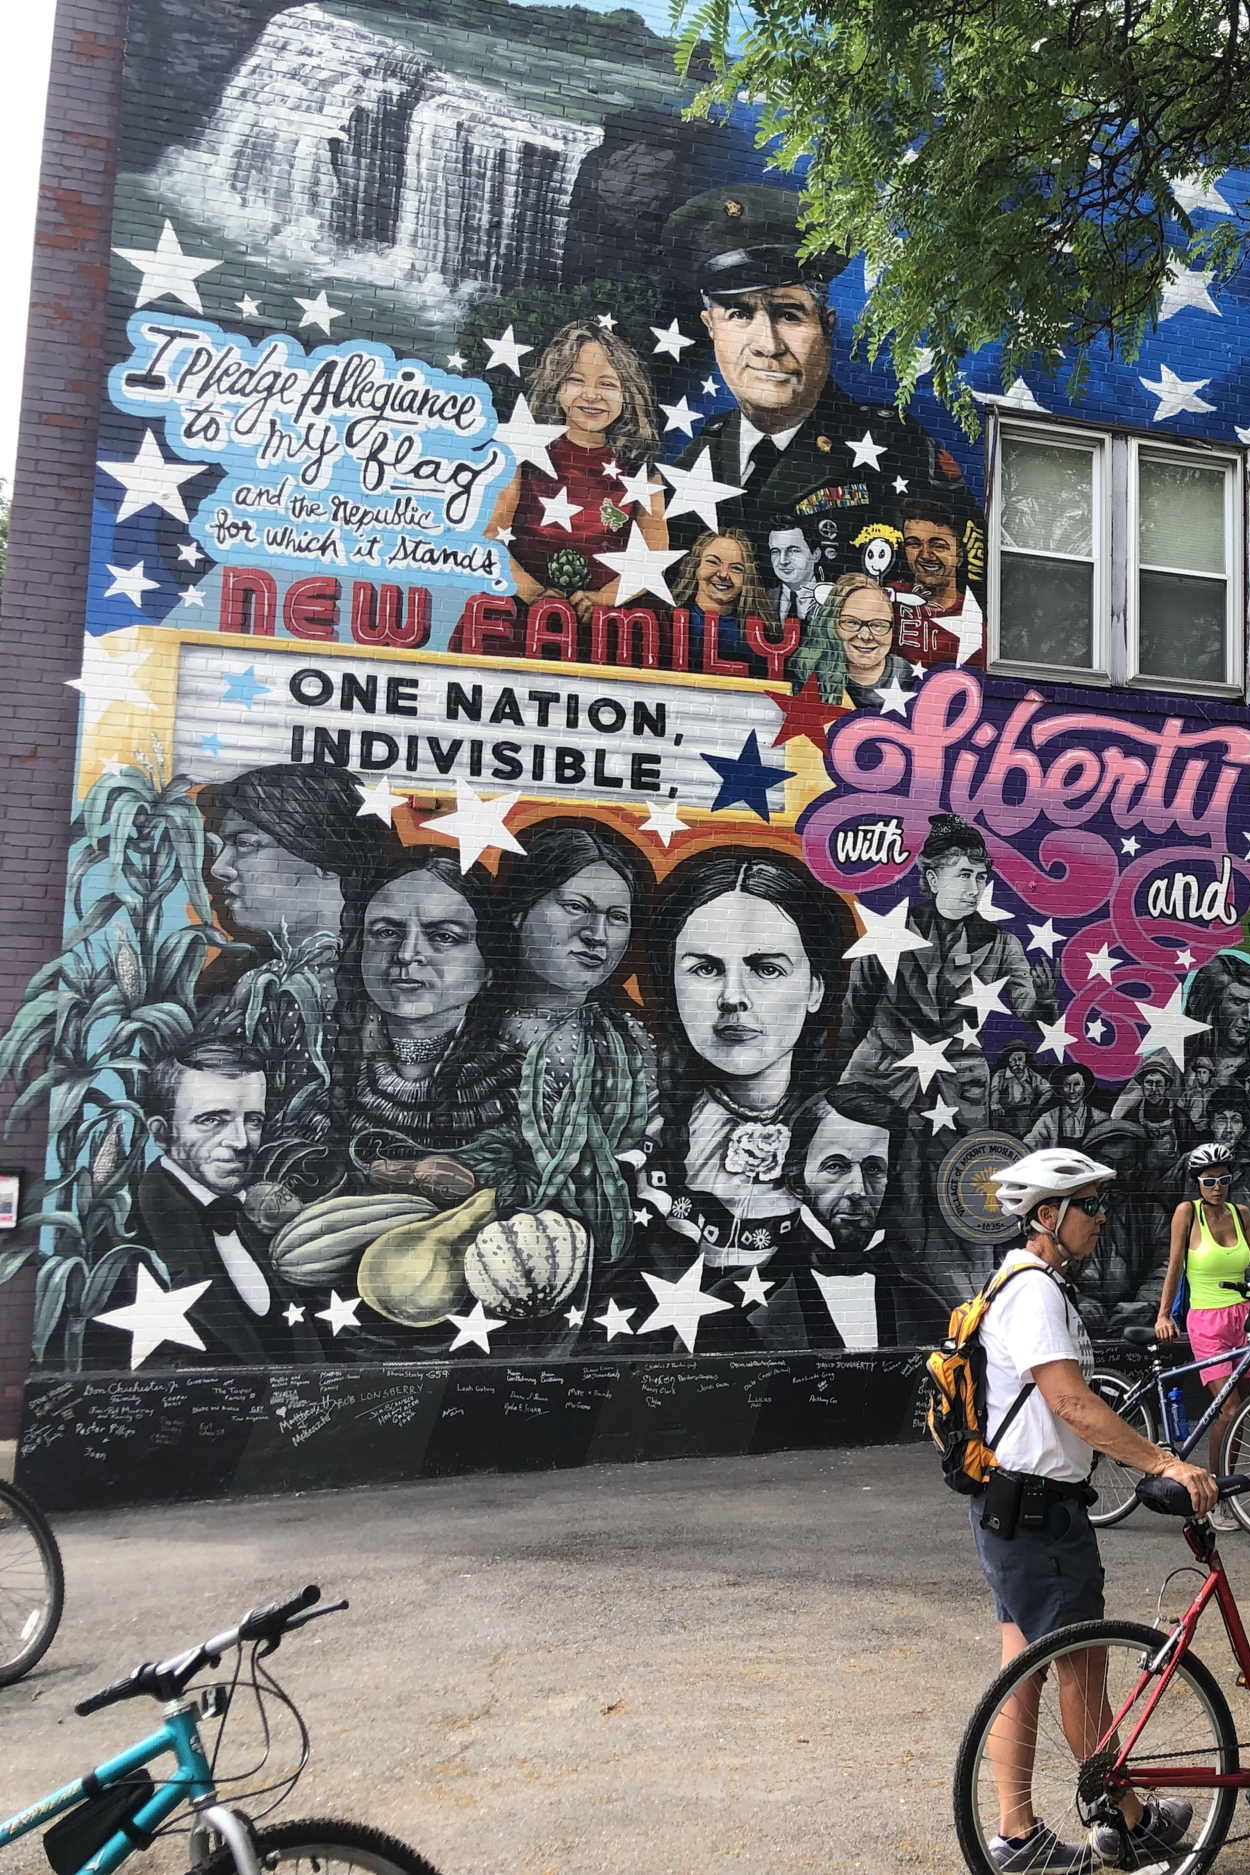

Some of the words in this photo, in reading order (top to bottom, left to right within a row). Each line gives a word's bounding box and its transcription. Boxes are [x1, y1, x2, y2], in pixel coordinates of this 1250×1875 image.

[124, 326, 200, 389] I
[178, 343, 301, 435] Pledge
[296, 353, 479, 448] Allegiance
[183, 404, 223, 442] to
[262, 419, 341, 482] my
[362, 432, 498, 525] flag
[234, 476, 289, 508] and
[290, 495, 329, 520] the
[210, 510, 259, 545] for
[265, 528, 341, 559] which
[352, 535, 380, 560] it
[462, 592, 799, 680] FAMILY
[289, 667, 419, 716] ONE
[446, 681, 684, 746] NATION,
[291, 725, 678, 799] INDIVISIBLE,
[836, 819, 909, 864] with
[1148, 856, 1237, 926] and
[950, 1179, 965, 1217] VILLAGE
[961, 1146, 987, 1167] MOUNT
[360, 1382, 424, 1400] LONSBERRY
